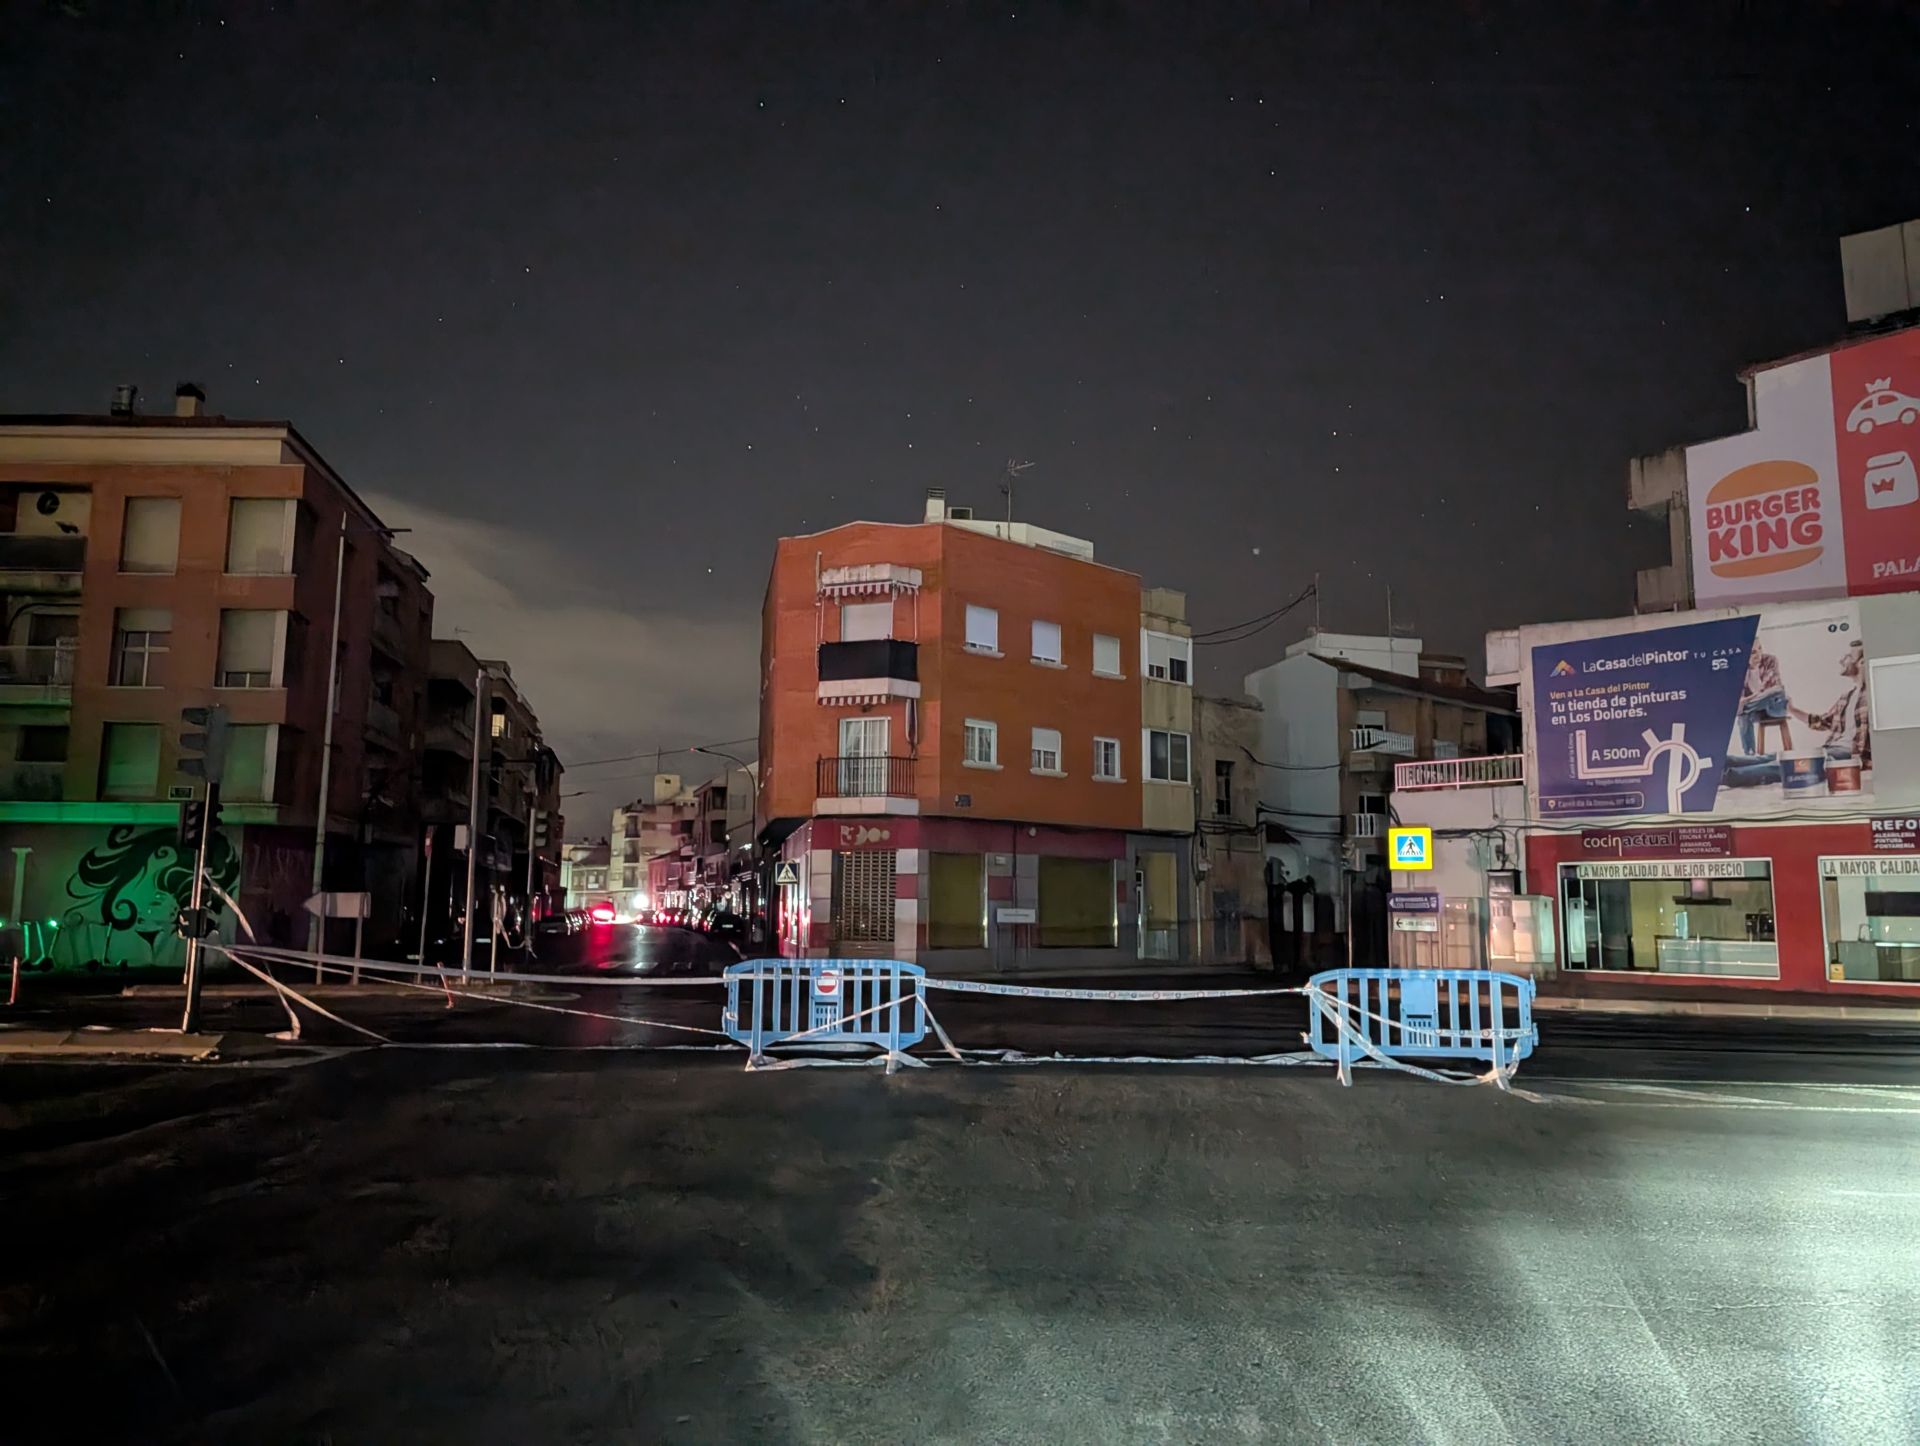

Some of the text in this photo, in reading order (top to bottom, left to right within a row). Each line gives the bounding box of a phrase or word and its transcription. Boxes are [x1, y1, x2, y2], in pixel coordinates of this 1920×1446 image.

[1706, 487, 1821, 530] BURGER
[1708, 511, 1823, 562] KING
[1712, 647, 1742, 657] CASA
[1582, 650, 1689, 673] LaCasadelPintor
[1550, 691, 1566, 700] Ven
[1574, 689, 1584, 697] La
[1585, 687, 1606, 696] Casa
[1607, 683, 1621, 693] del
[1622, 682, 1650, 692] Pintor
[1550, 690, 1687, 713] Tu tienda de pinturas
[1551, 707, 1648, 725] en Los Dolores.
[1591, 747, 1641, 762] A 500m
[1871, 819, 1920, 831] REFO
[1579, 863, 1742, 878] LA MAYOR CALIDAD AL MEJOR PRECIO
[1823, 861, 1836, 875] LA
[1840, 860, 1877, 875] MAYOR
